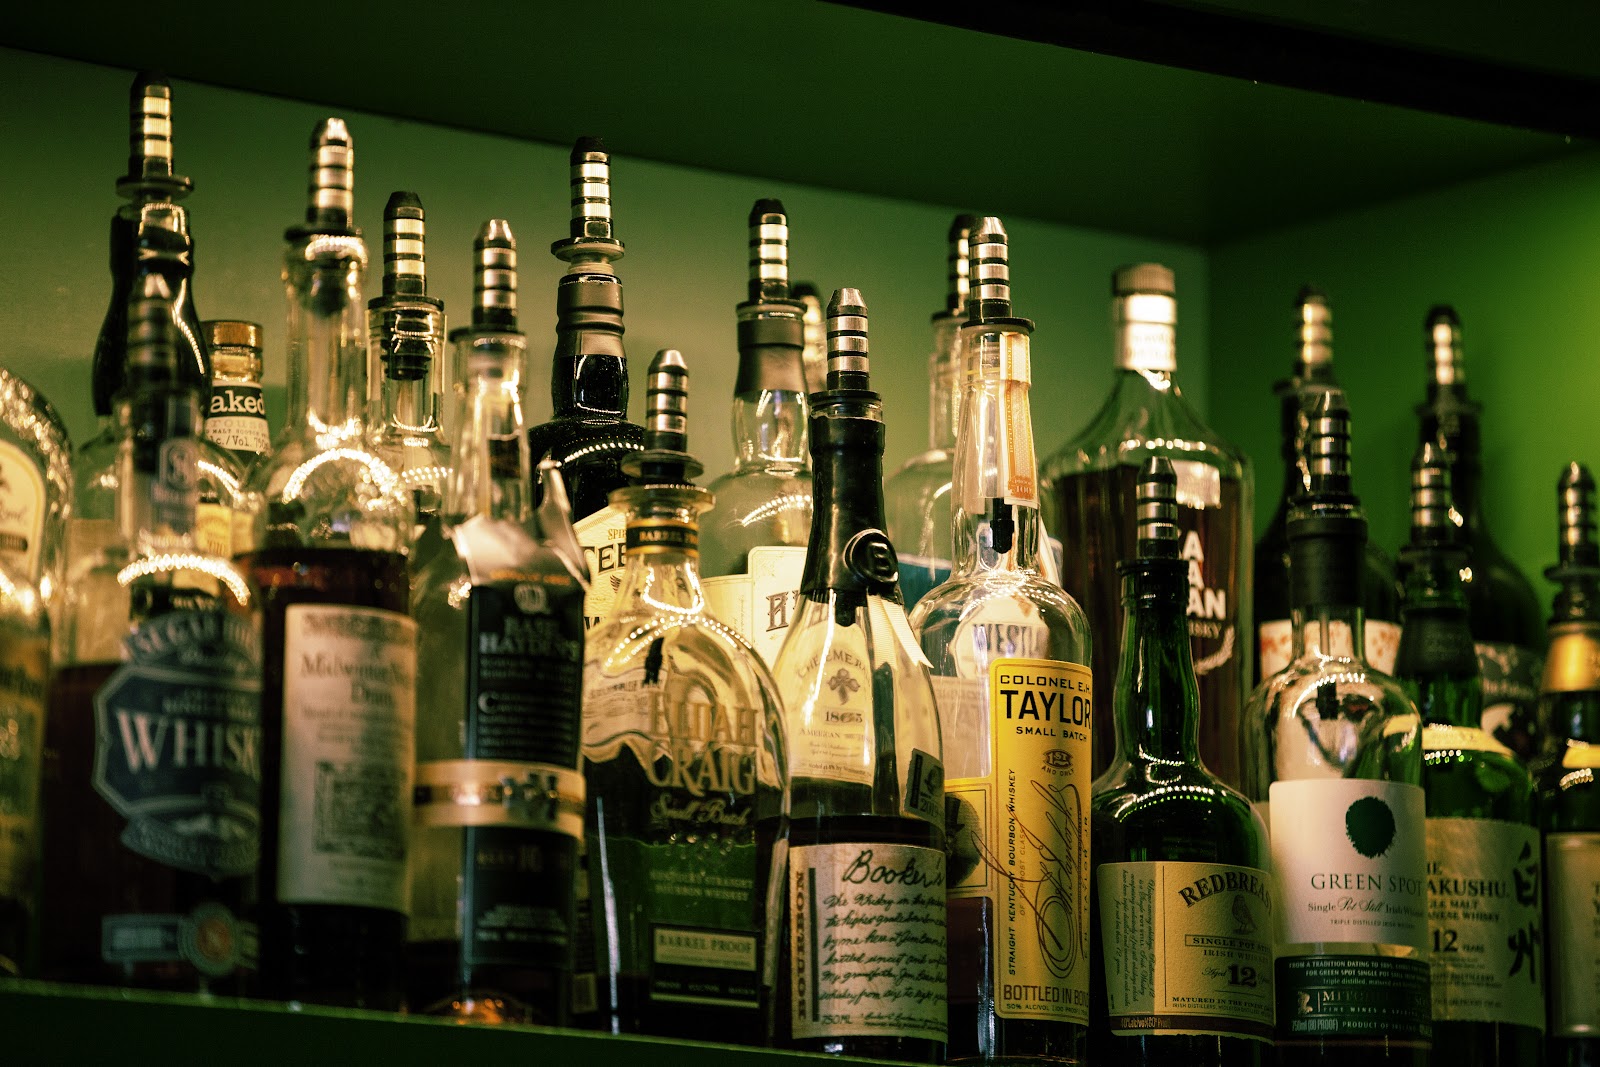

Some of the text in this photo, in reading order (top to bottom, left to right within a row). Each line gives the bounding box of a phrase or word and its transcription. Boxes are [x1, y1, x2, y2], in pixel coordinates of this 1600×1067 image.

[1000, 674, 1074, 690] COLONEL
[825, 711, 863, 724] 1865
[1000, 690, 1091, 730] TAYLOR
[1016, 726, 1087, 742] SMALL BATCH
[648, 740, 757, 797] CRAIG
[842, 849, 944, 888] Booker's
[1008, 768, 1016, 976] STRAIGHT KENTUCKY BOURBON WHISKEY
[1311, 872, 1422, 896] GREEN SPOT
[1020, 904, 1026, 916] OF
[1308, 902, 1337, 914] Single
[1193, 937, 1255, 950] SINGLE POT
[1433, 928, 1459, 952] 12
[1203, 950, 1234, 958] IRISH
[1312, 960, 1346, 968] TRADITION
[1202, 964, 1257, 988] Aged 12
[1323, 978, 1340, 986] triple
[1004, 984, 1060, 1002] BOTTLED
[1062, 988, 1072, 1004] IN
[1318, 1018, 1339, 1032] PROOF)
[1342, 1021, 1378, 1029] PRODUCT
